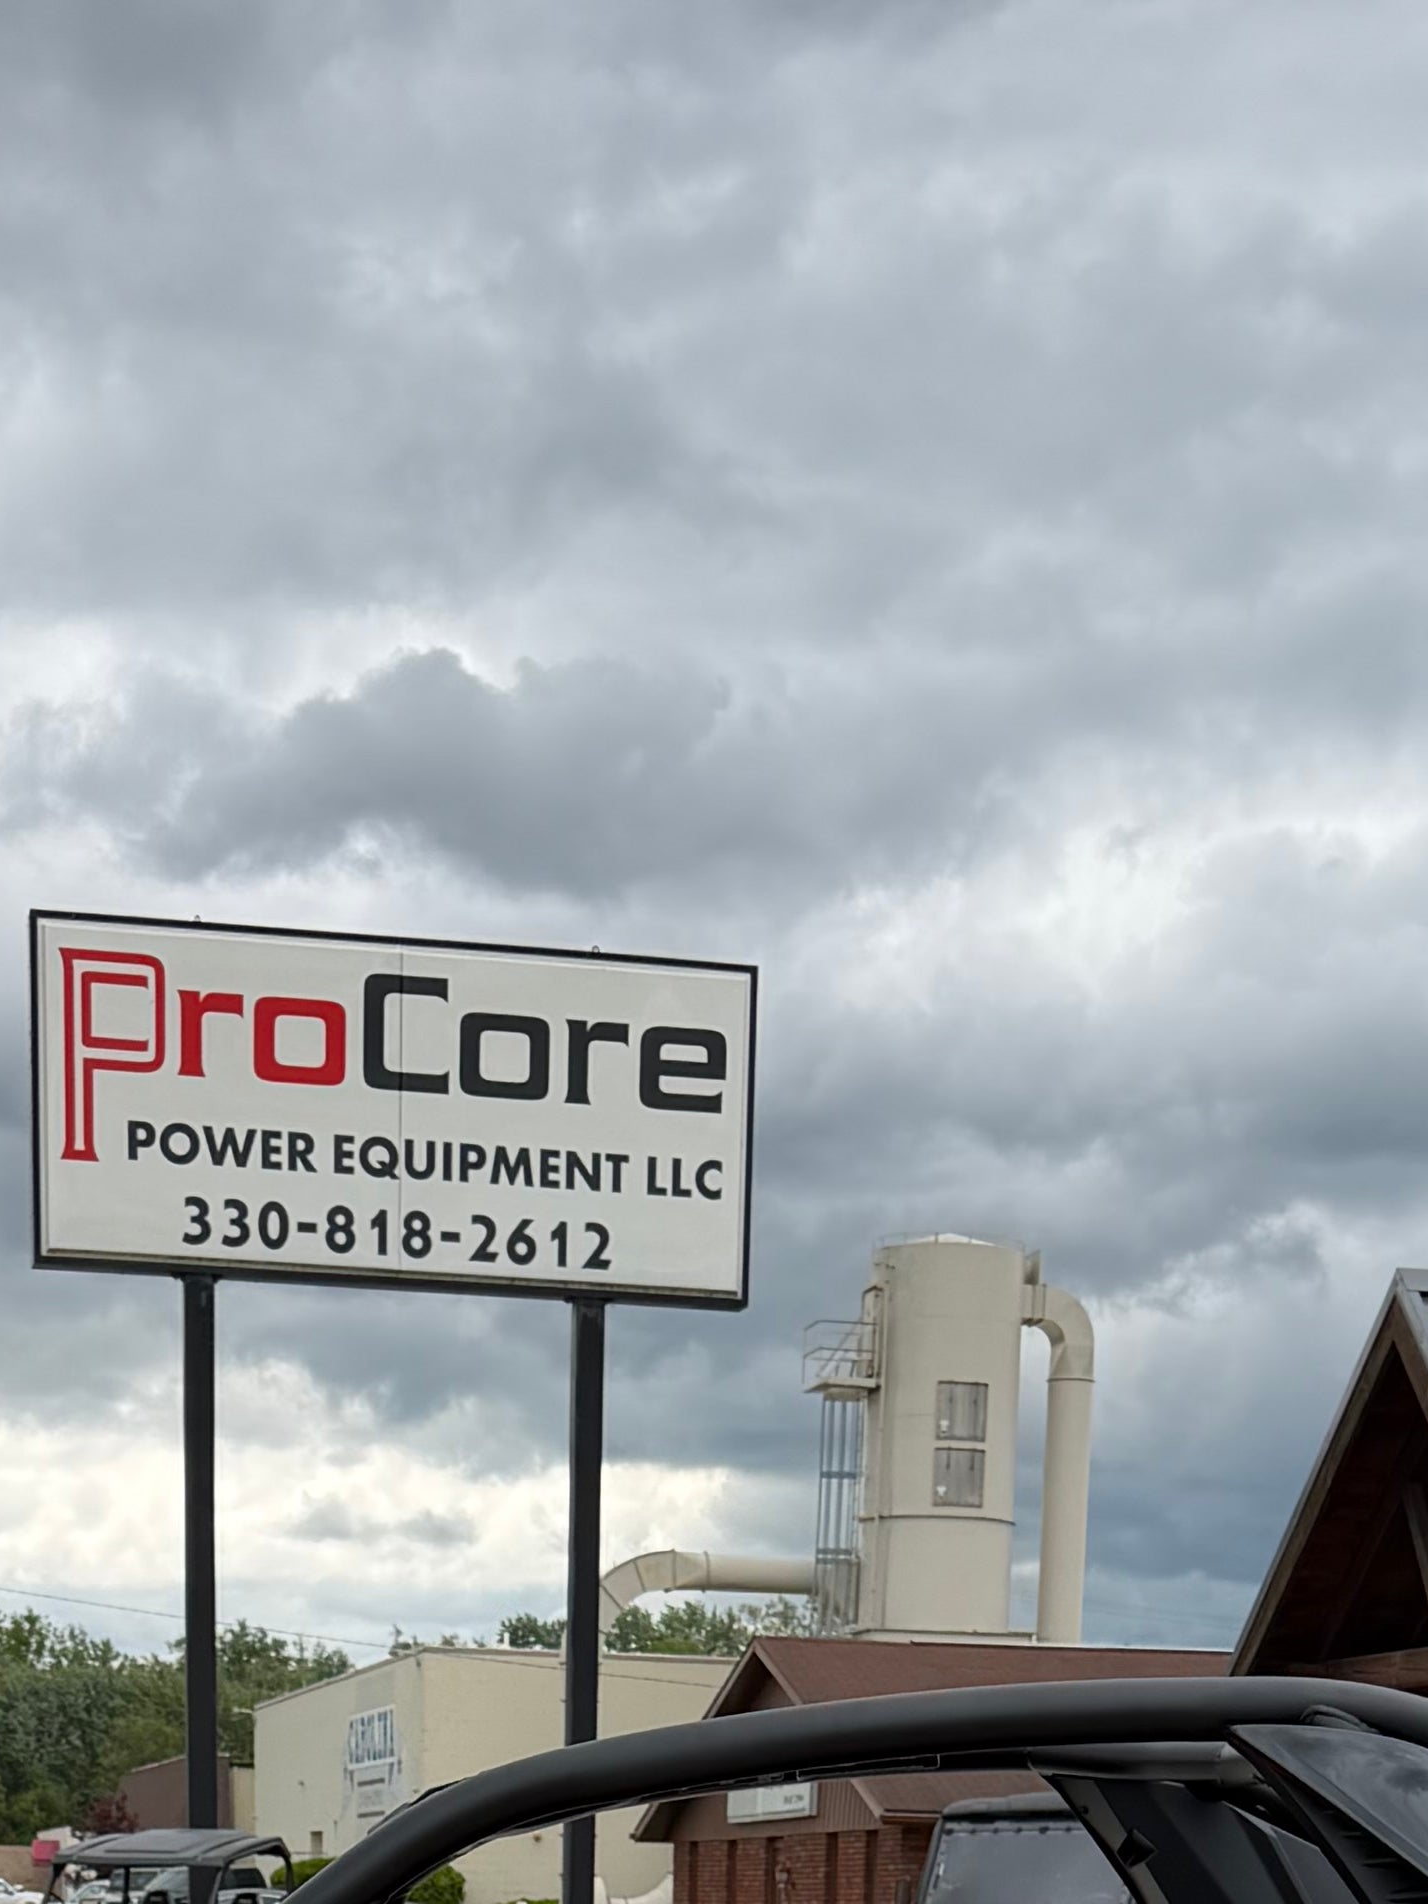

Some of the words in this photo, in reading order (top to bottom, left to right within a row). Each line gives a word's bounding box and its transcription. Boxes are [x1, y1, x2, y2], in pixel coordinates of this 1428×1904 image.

[59, 946, 728, 1162] ProCore
[127, 1120, 316, 1174] POWER
[333, 1135, 629, 1197] EQUIPMENT
[646, 1155, 723, 1200] LLC
[182, 1196, 612, 1271] 330-818-2612
